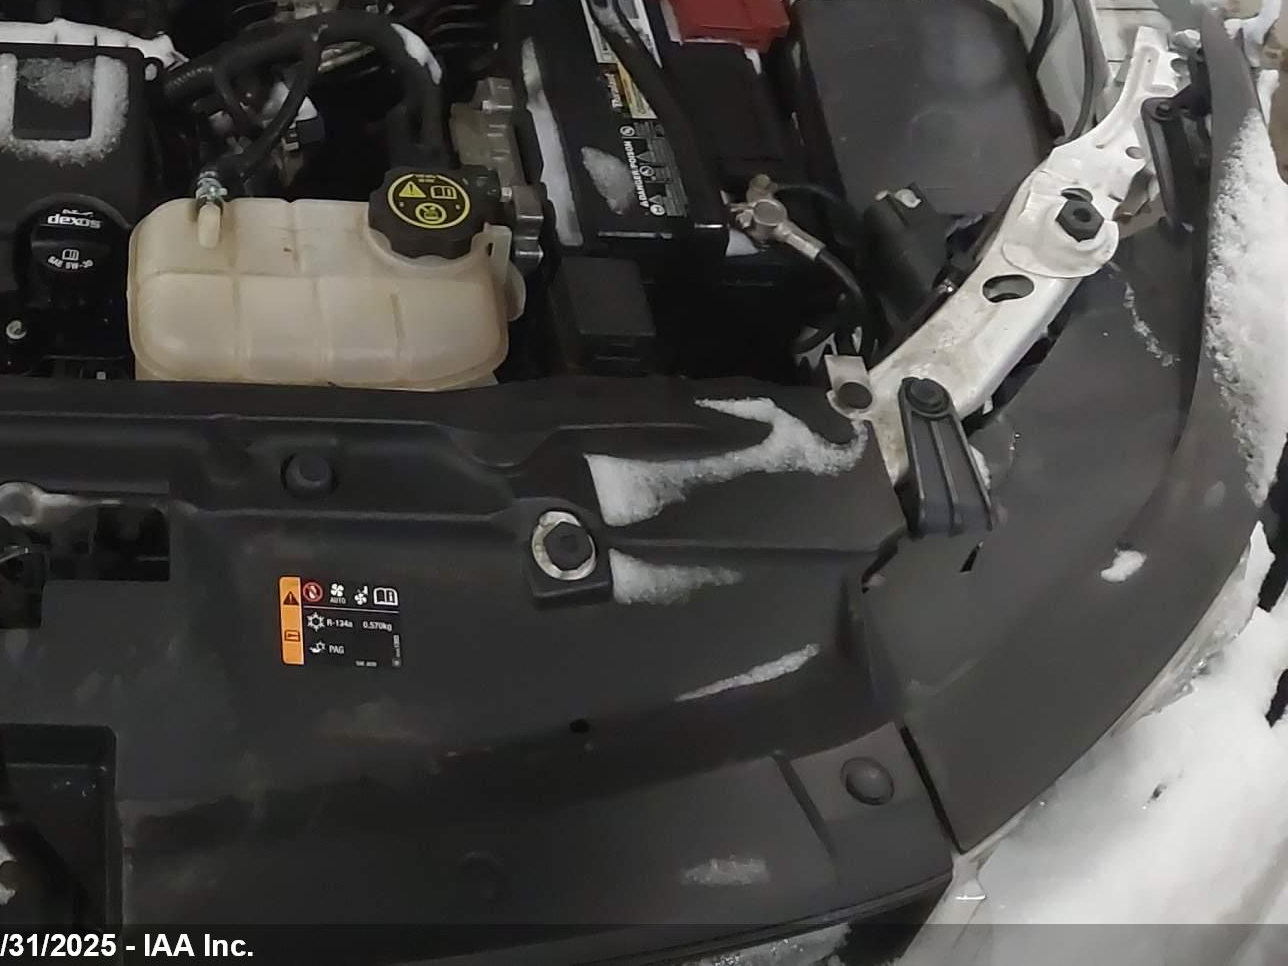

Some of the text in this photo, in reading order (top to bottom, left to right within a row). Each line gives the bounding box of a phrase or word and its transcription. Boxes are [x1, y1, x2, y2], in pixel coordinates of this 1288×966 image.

[47, 213, 102, 229] dexos
[329, 596, 347, 604] AUTO
[326, 618, 353, 628] R-134a
[329, 645, 345, 654] PAG
